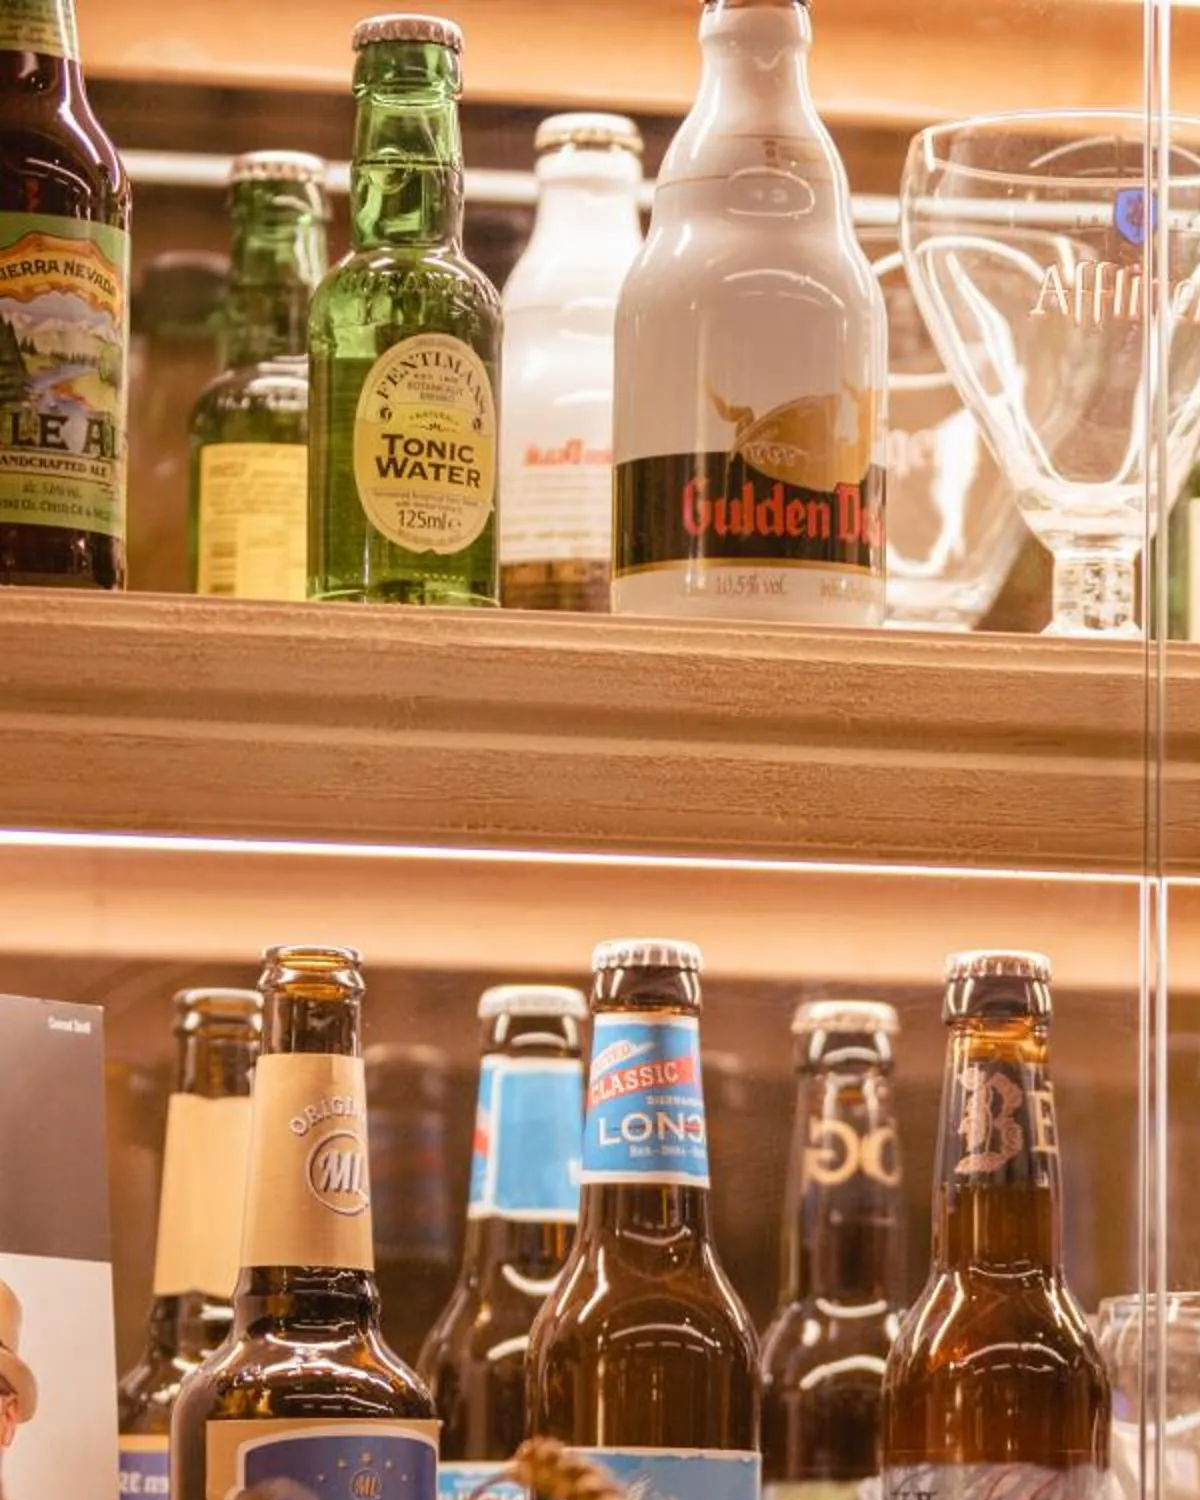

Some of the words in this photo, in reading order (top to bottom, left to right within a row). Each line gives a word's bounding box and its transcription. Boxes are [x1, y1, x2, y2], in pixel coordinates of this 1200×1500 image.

[0, 259, 59, 280] IERRA
[0, 455, 87, 473] ANDCRAFTED
[381, 433, 475, 464] TONIC
[375, 456, 482, 489] WATER
[398, 510, 447, 530] 125ml
[682, 475, 832, 541] Gulden
[591, 1060, 680, 1105] CLASSIC
